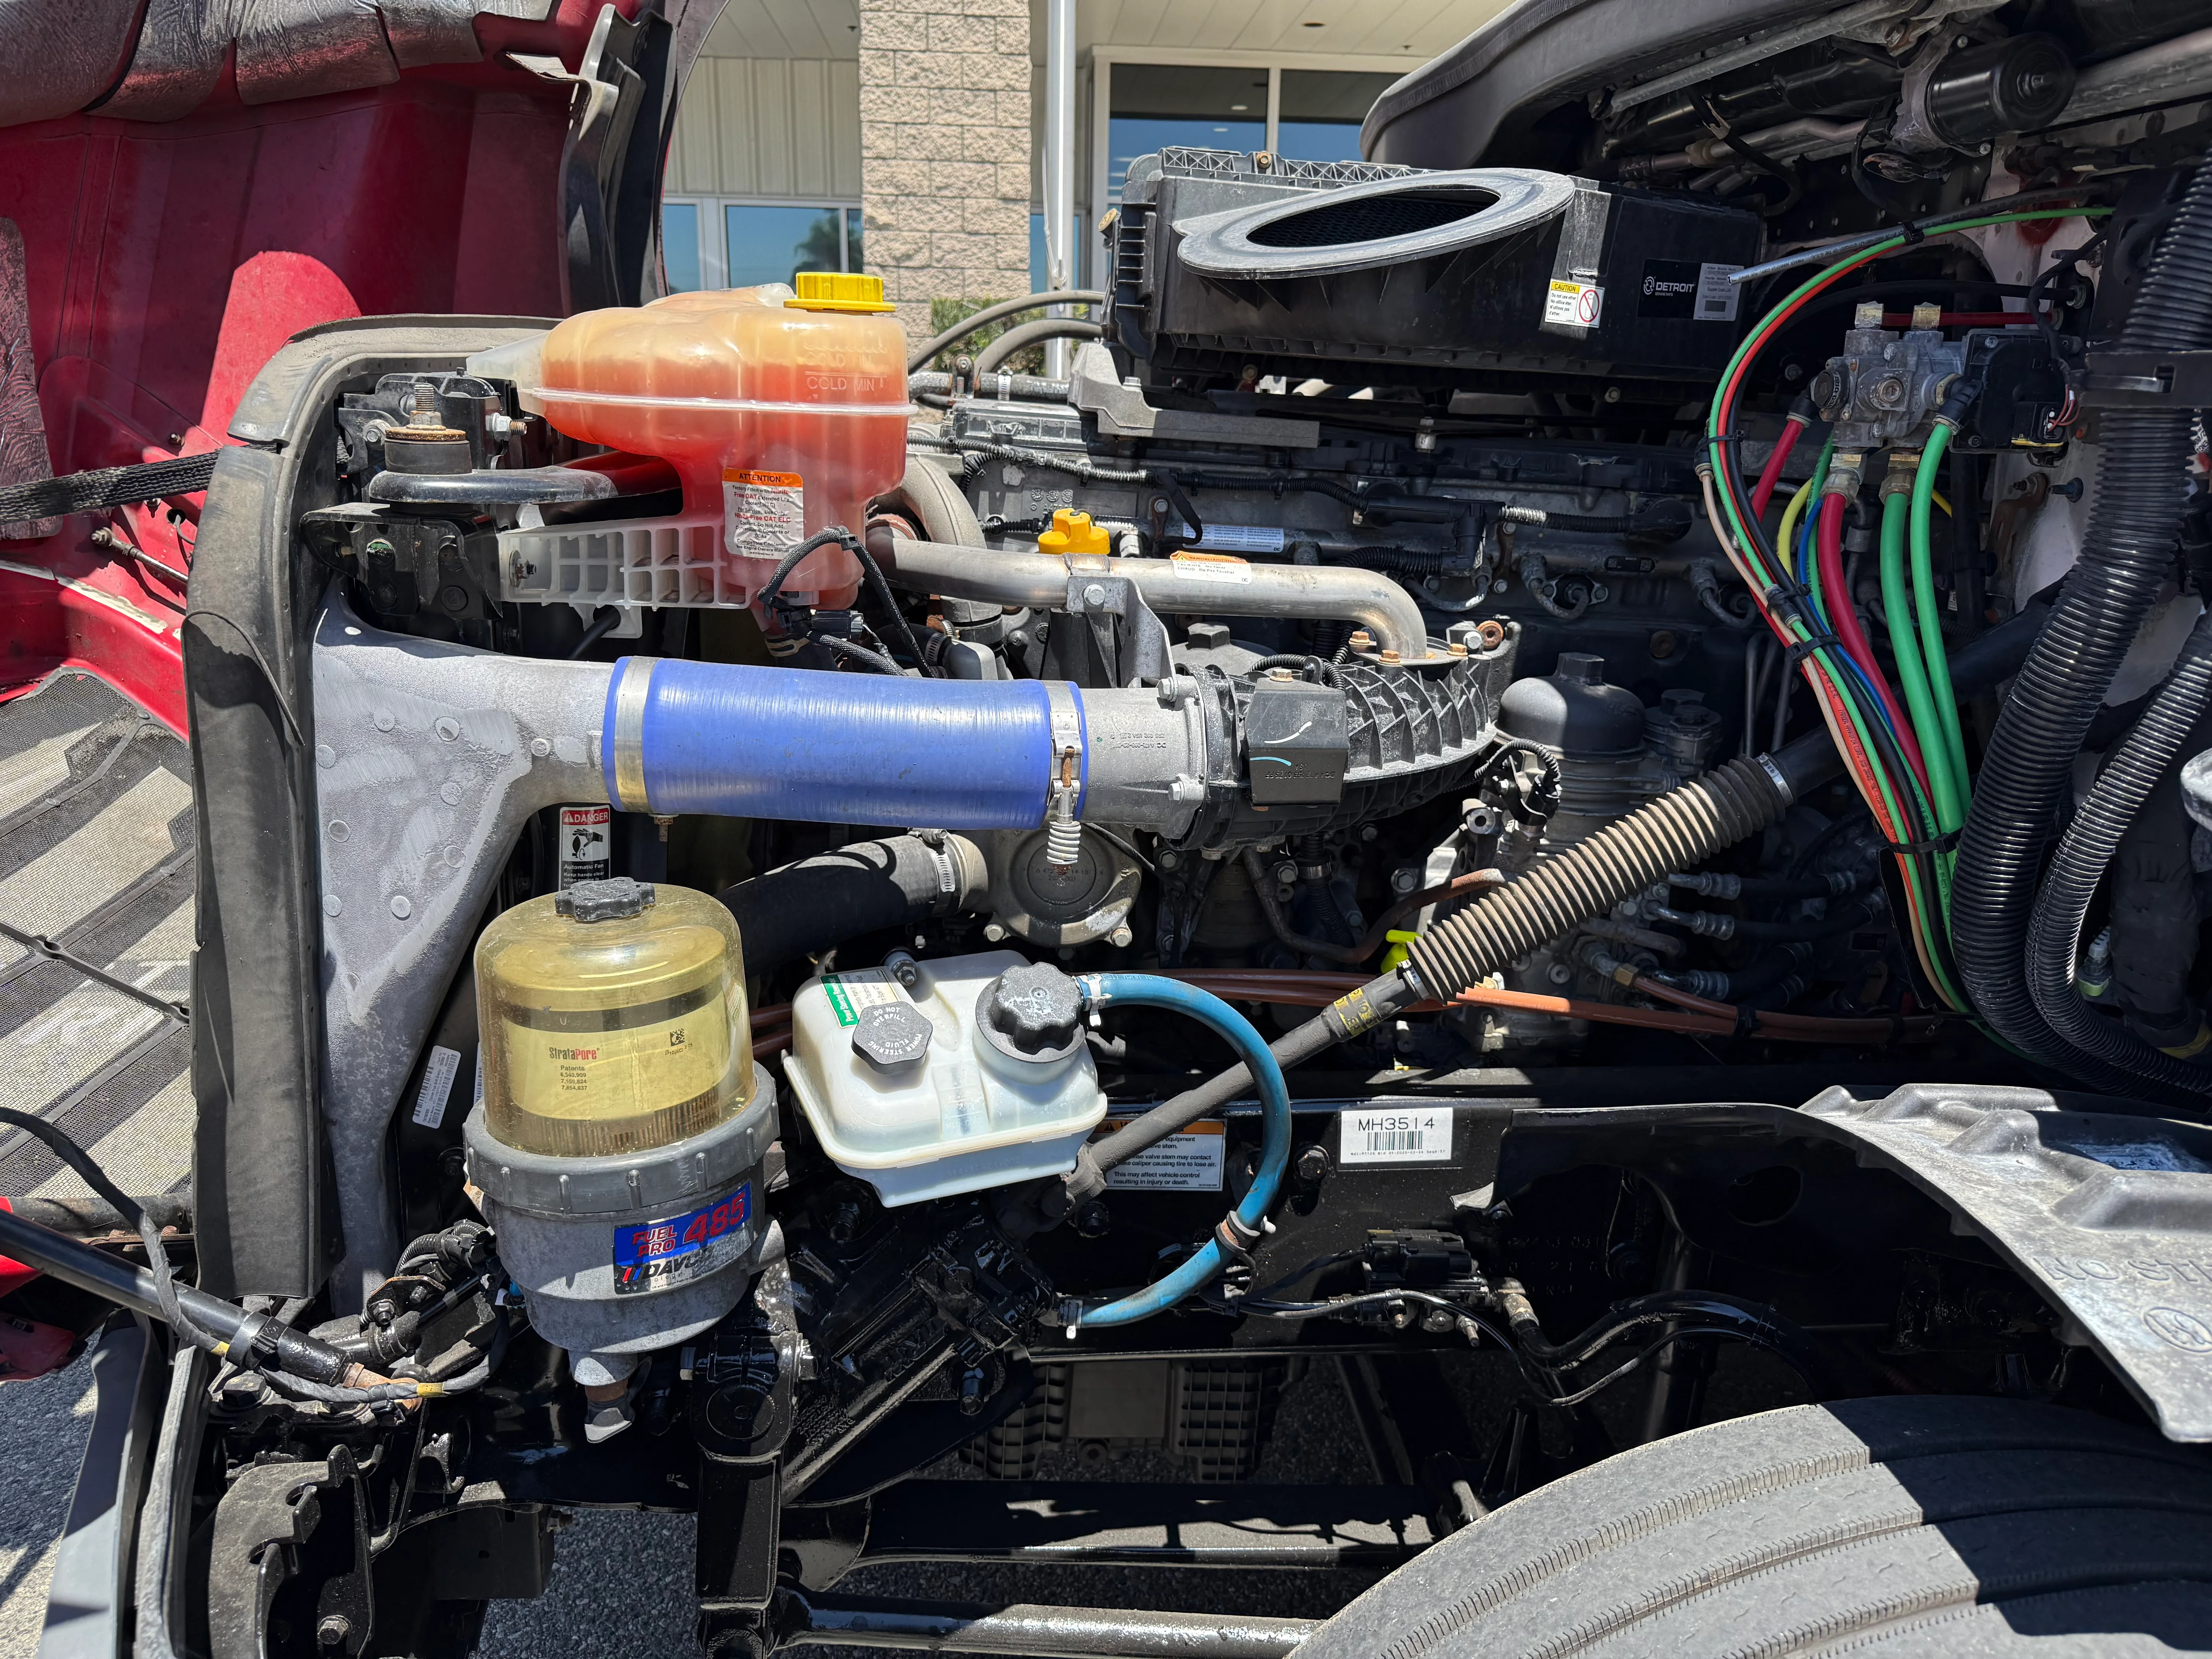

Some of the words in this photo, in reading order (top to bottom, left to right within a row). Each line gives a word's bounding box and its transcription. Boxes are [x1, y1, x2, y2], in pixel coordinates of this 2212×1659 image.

[1554, 283, 1576, 293] CAUTION
[1656, 282, 1694, 292] DETROIT
[807, 376, 847, 390] COLD
[854, 378, 874, 391] MIN
[739, 473, 781, 483] ATTENTION
[735, 512, 763, 521] Nitrite-Free
[574, 812, 608, 823] DANGER
[834, 993, 850, 1011] Steering
[841, 1007, 855, 1023] Power
[873, 1008, 883, 1017] DO
[873, 1013, 905, 1027] OVERFILL
[868, 1041, 903, 1055] STEERING
[885, 1038, 909, 1048] FLUID
[907, 1033, 922, 1052] POWER
[1358, 1116, 1434, 1131] MH3514
[682, 1190, 745, 1244] 485
[632, 1224, 677, 1245] FUEL
[637, 1238, 676, 1257] PRO
